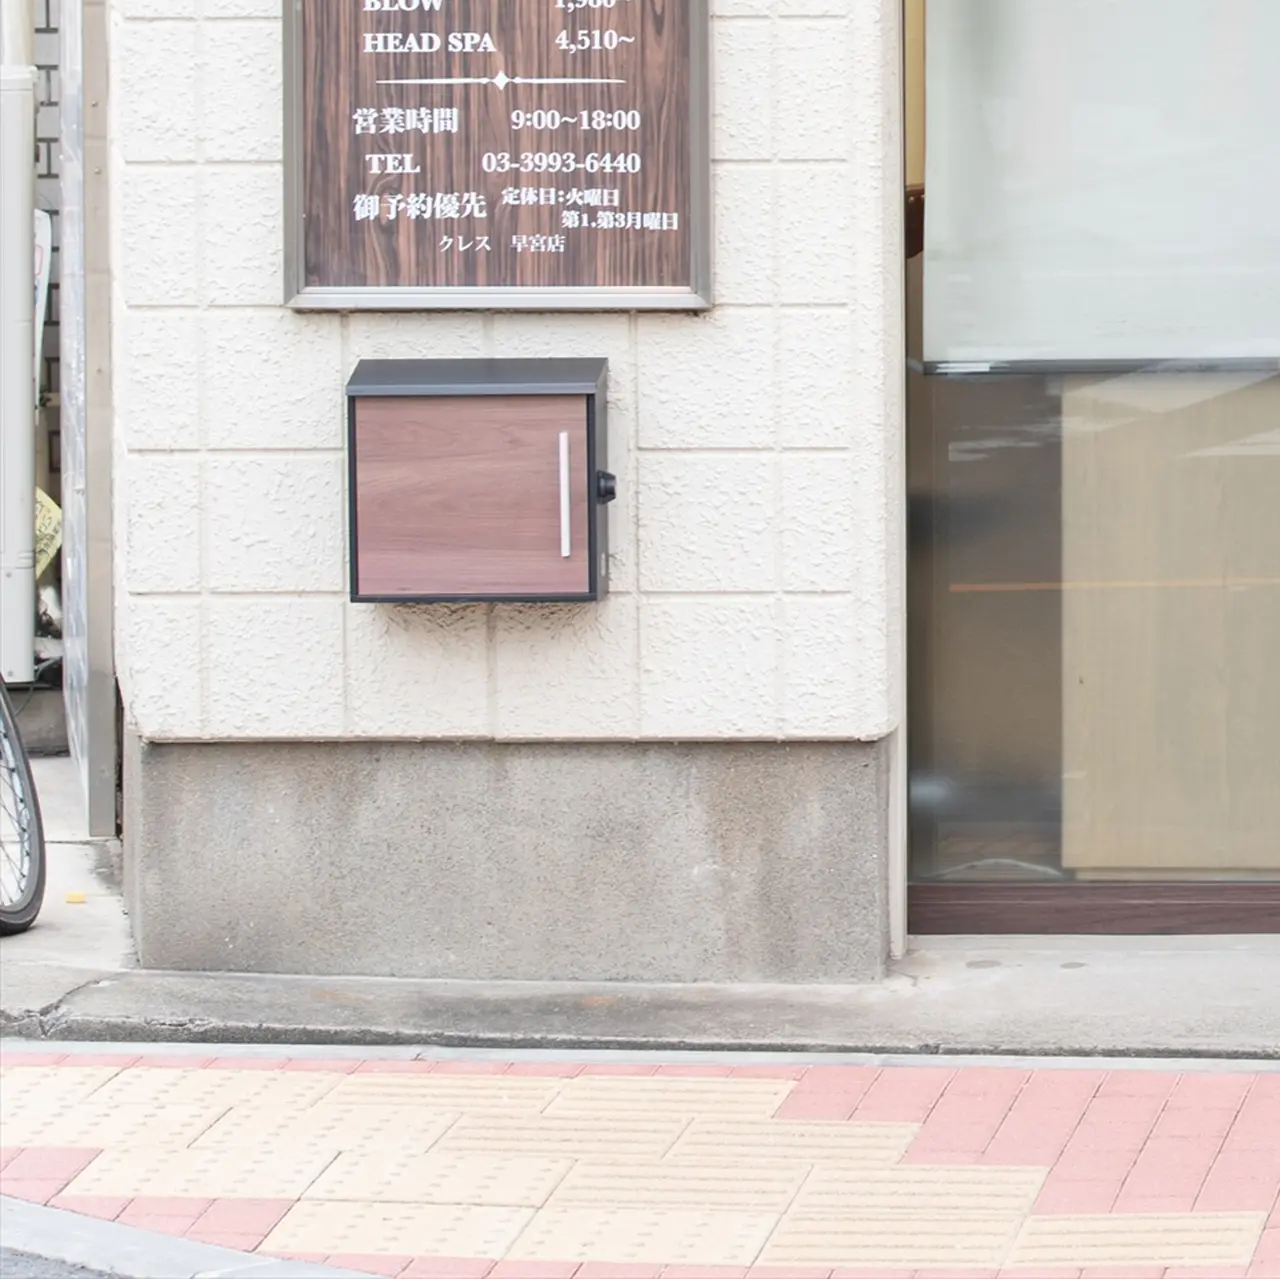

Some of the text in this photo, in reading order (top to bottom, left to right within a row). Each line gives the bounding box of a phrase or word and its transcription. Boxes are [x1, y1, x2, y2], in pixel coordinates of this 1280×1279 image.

[363, 29, 635, 55] HEAD SPA 4,510~
[352, 107, 459, 134] 営業時間
[365, 152, 641, 173] TEL 03-3993-6440
[353, 192, 488, 220] 御予約優先
[438, 234, 567, 253] クレス 早宮店
